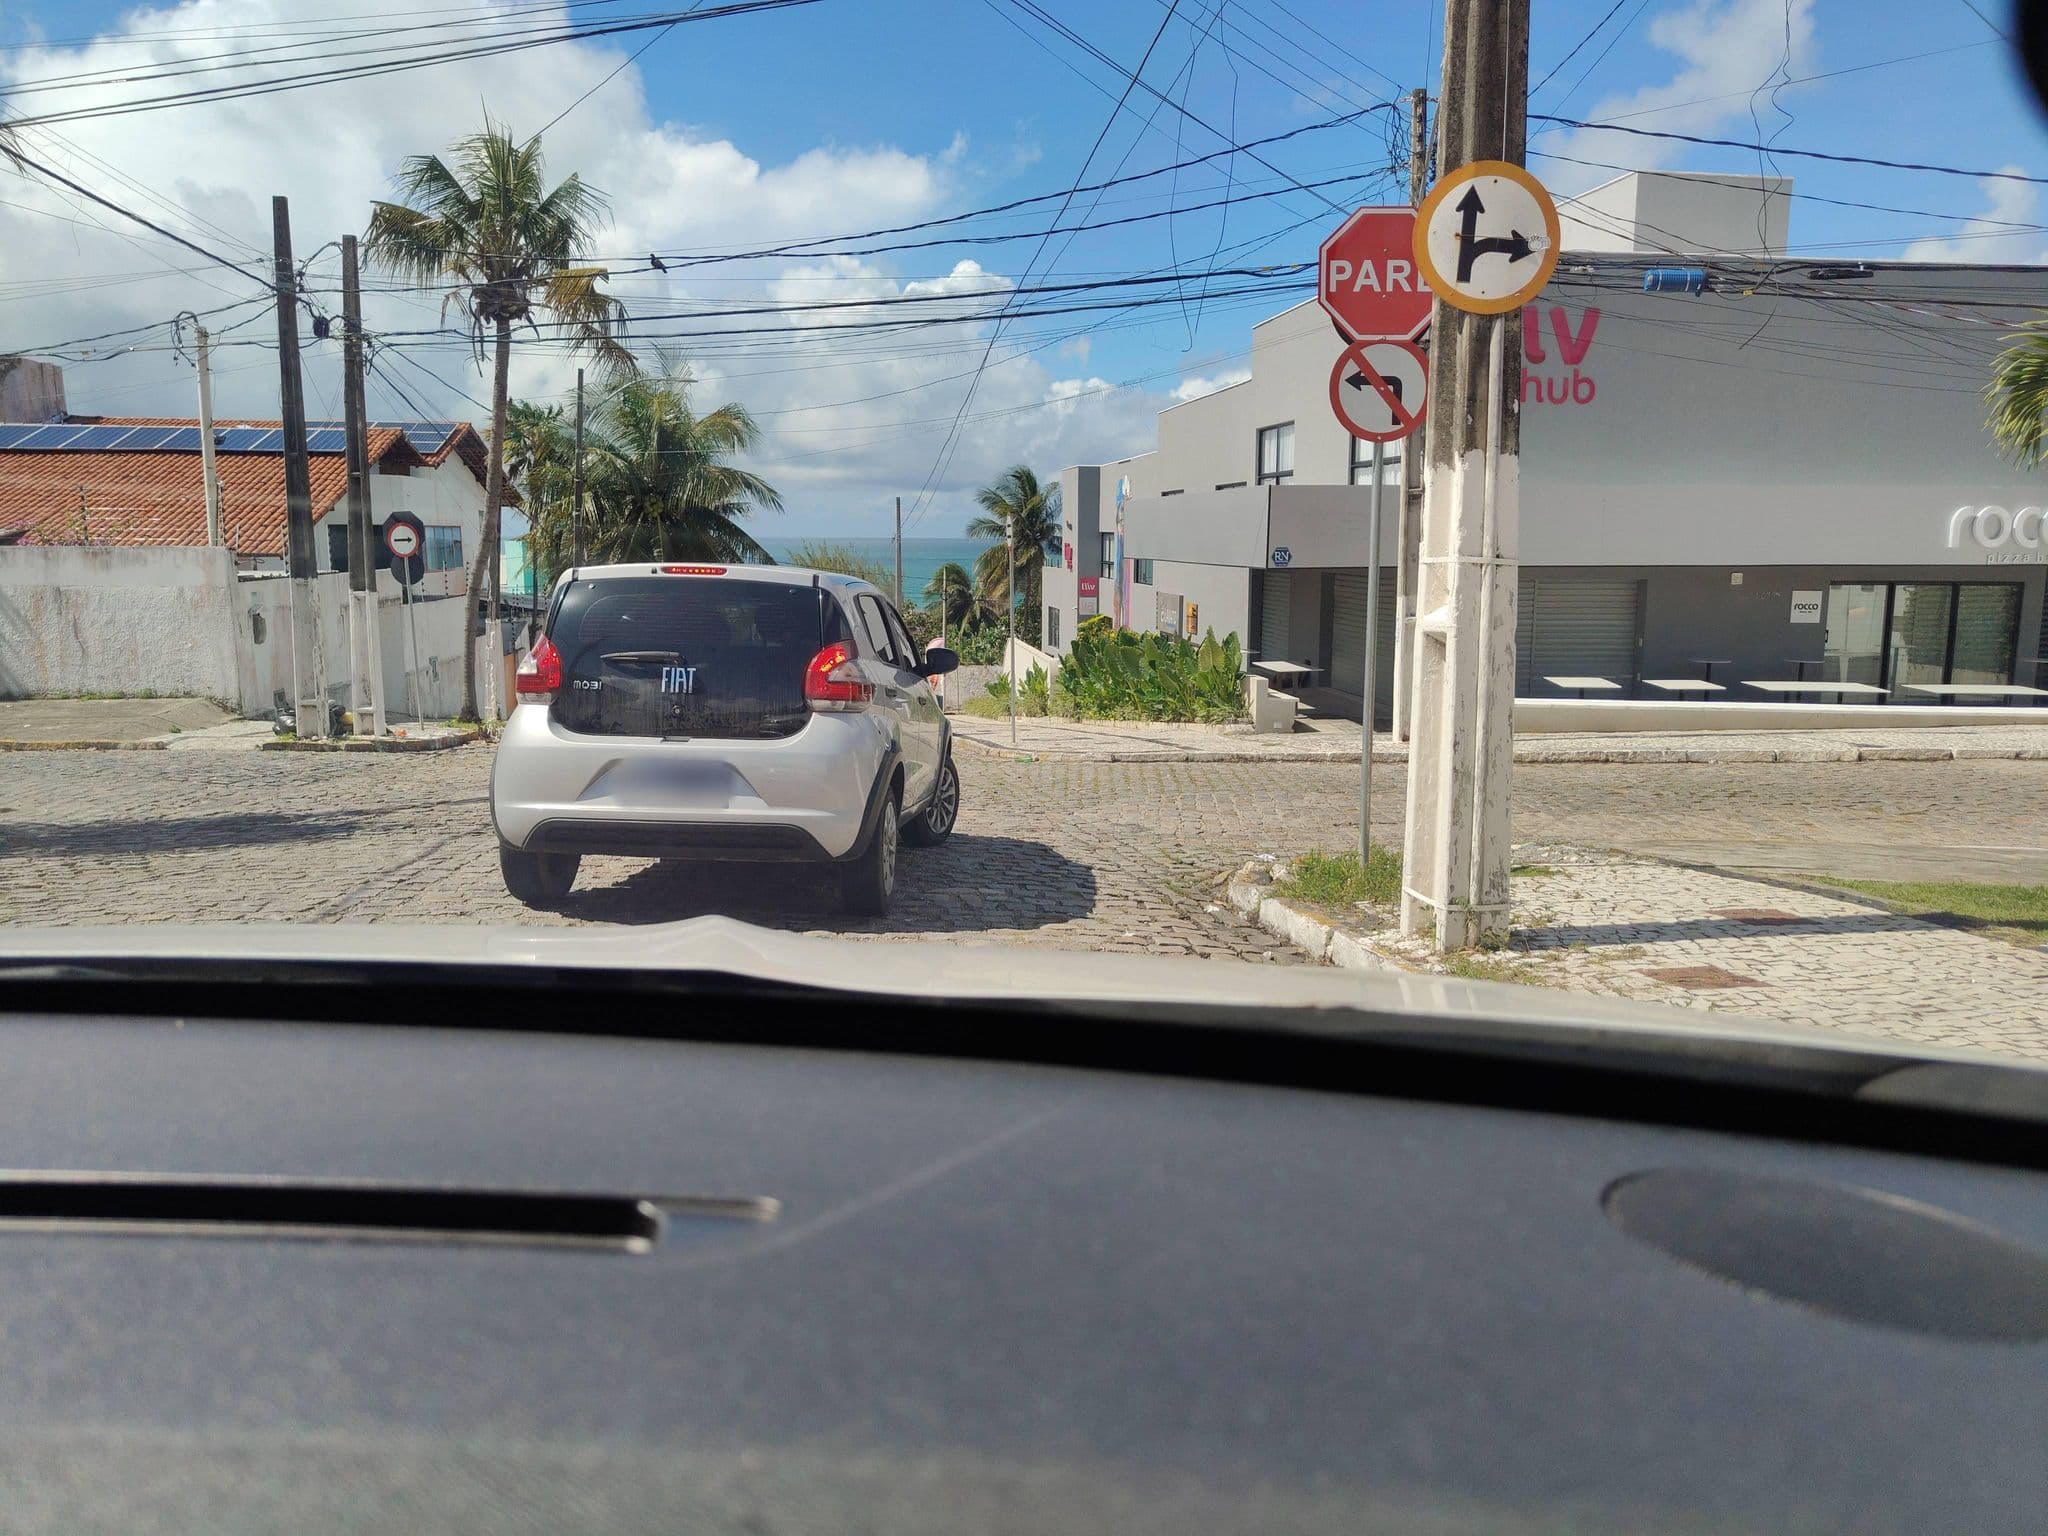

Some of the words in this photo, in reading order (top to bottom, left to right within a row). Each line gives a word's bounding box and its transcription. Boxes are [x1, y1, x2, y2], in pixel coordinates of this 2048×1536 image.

[1520, 368, 1595, 405] hub
[1946, 505, 2048, 549] roc
[1794, 603, 1819, 611] rocco
[661, 667, 696, 693] FIAT
